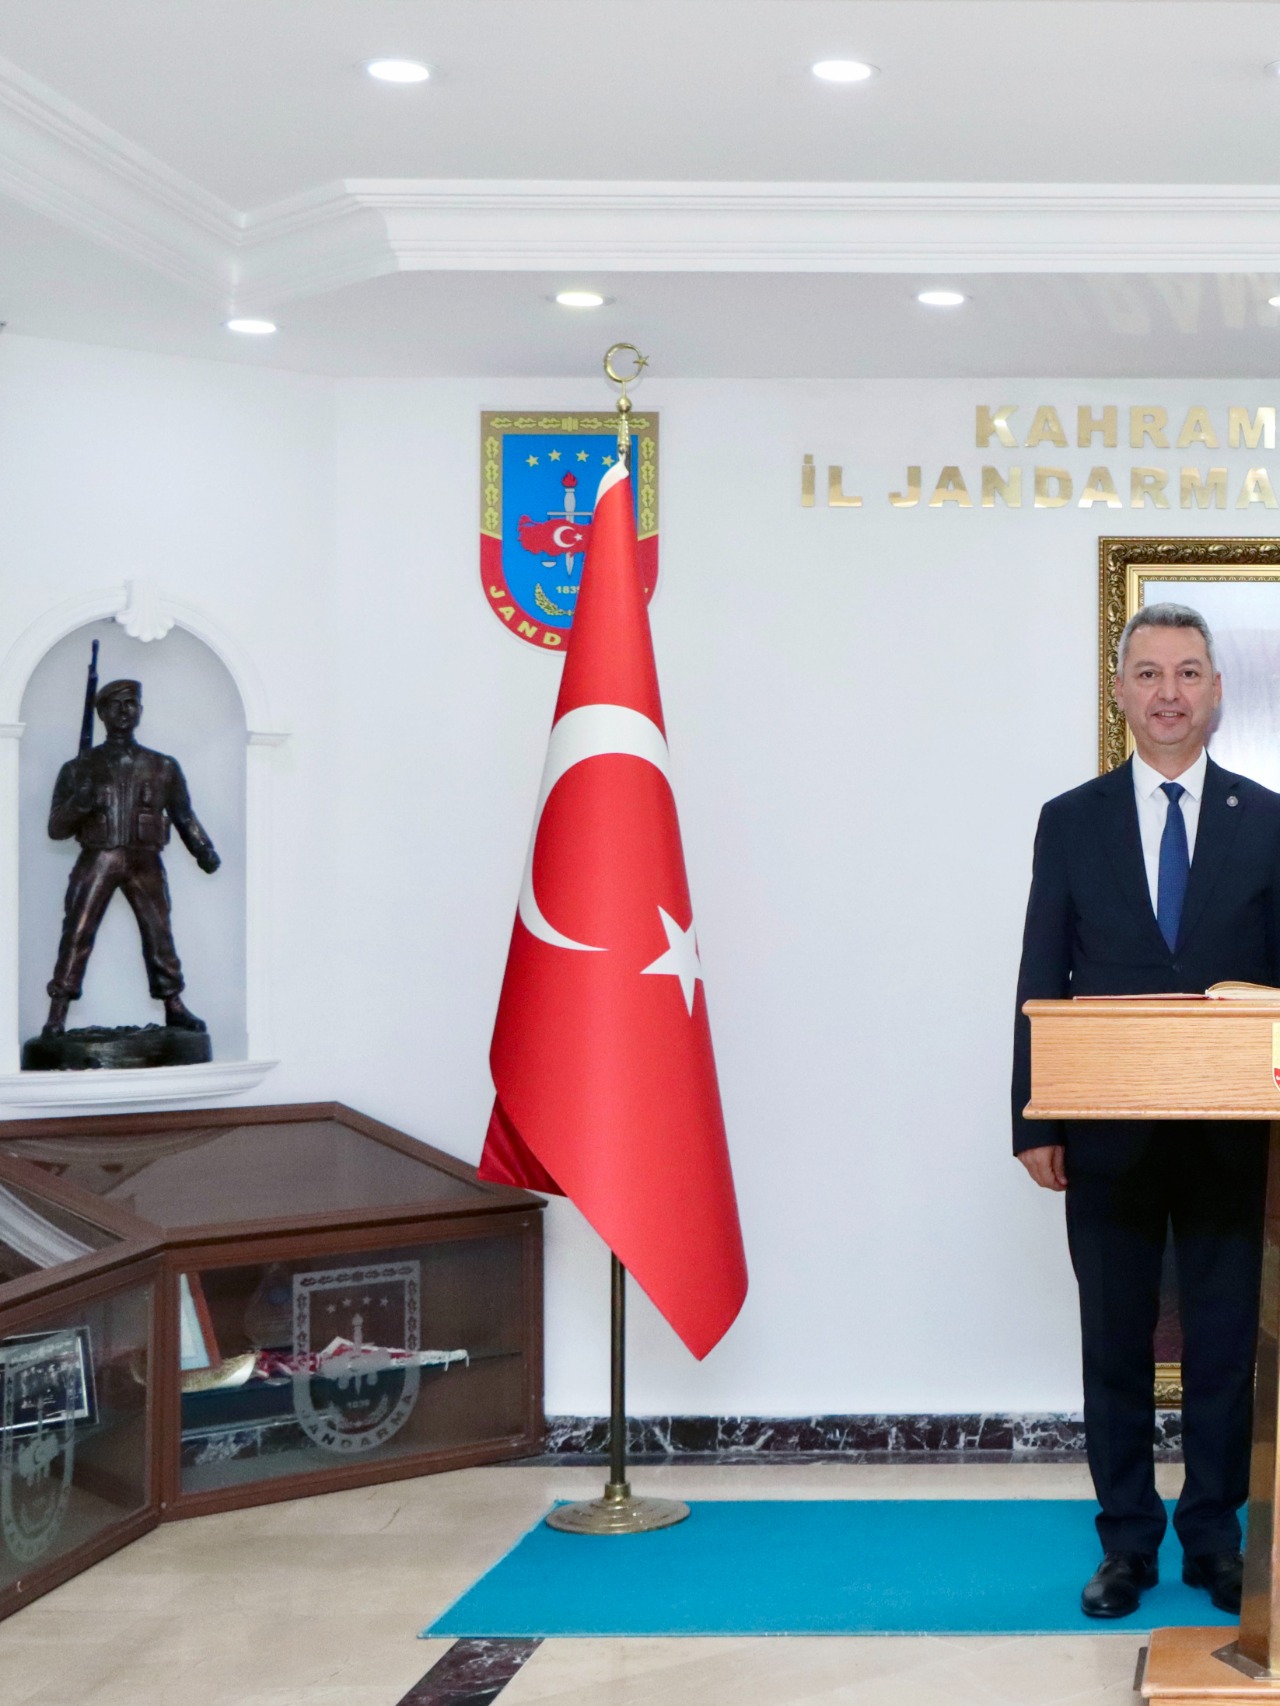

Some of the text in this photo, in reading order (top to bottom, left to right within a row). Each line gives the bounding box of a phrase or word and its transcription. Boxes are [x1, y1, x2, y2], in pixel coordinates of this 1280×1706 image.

[801, 454, 863, 508] İL
[888, 466, 1280, 510] JANDARMA
[489, 586, 562, 646] JAND
